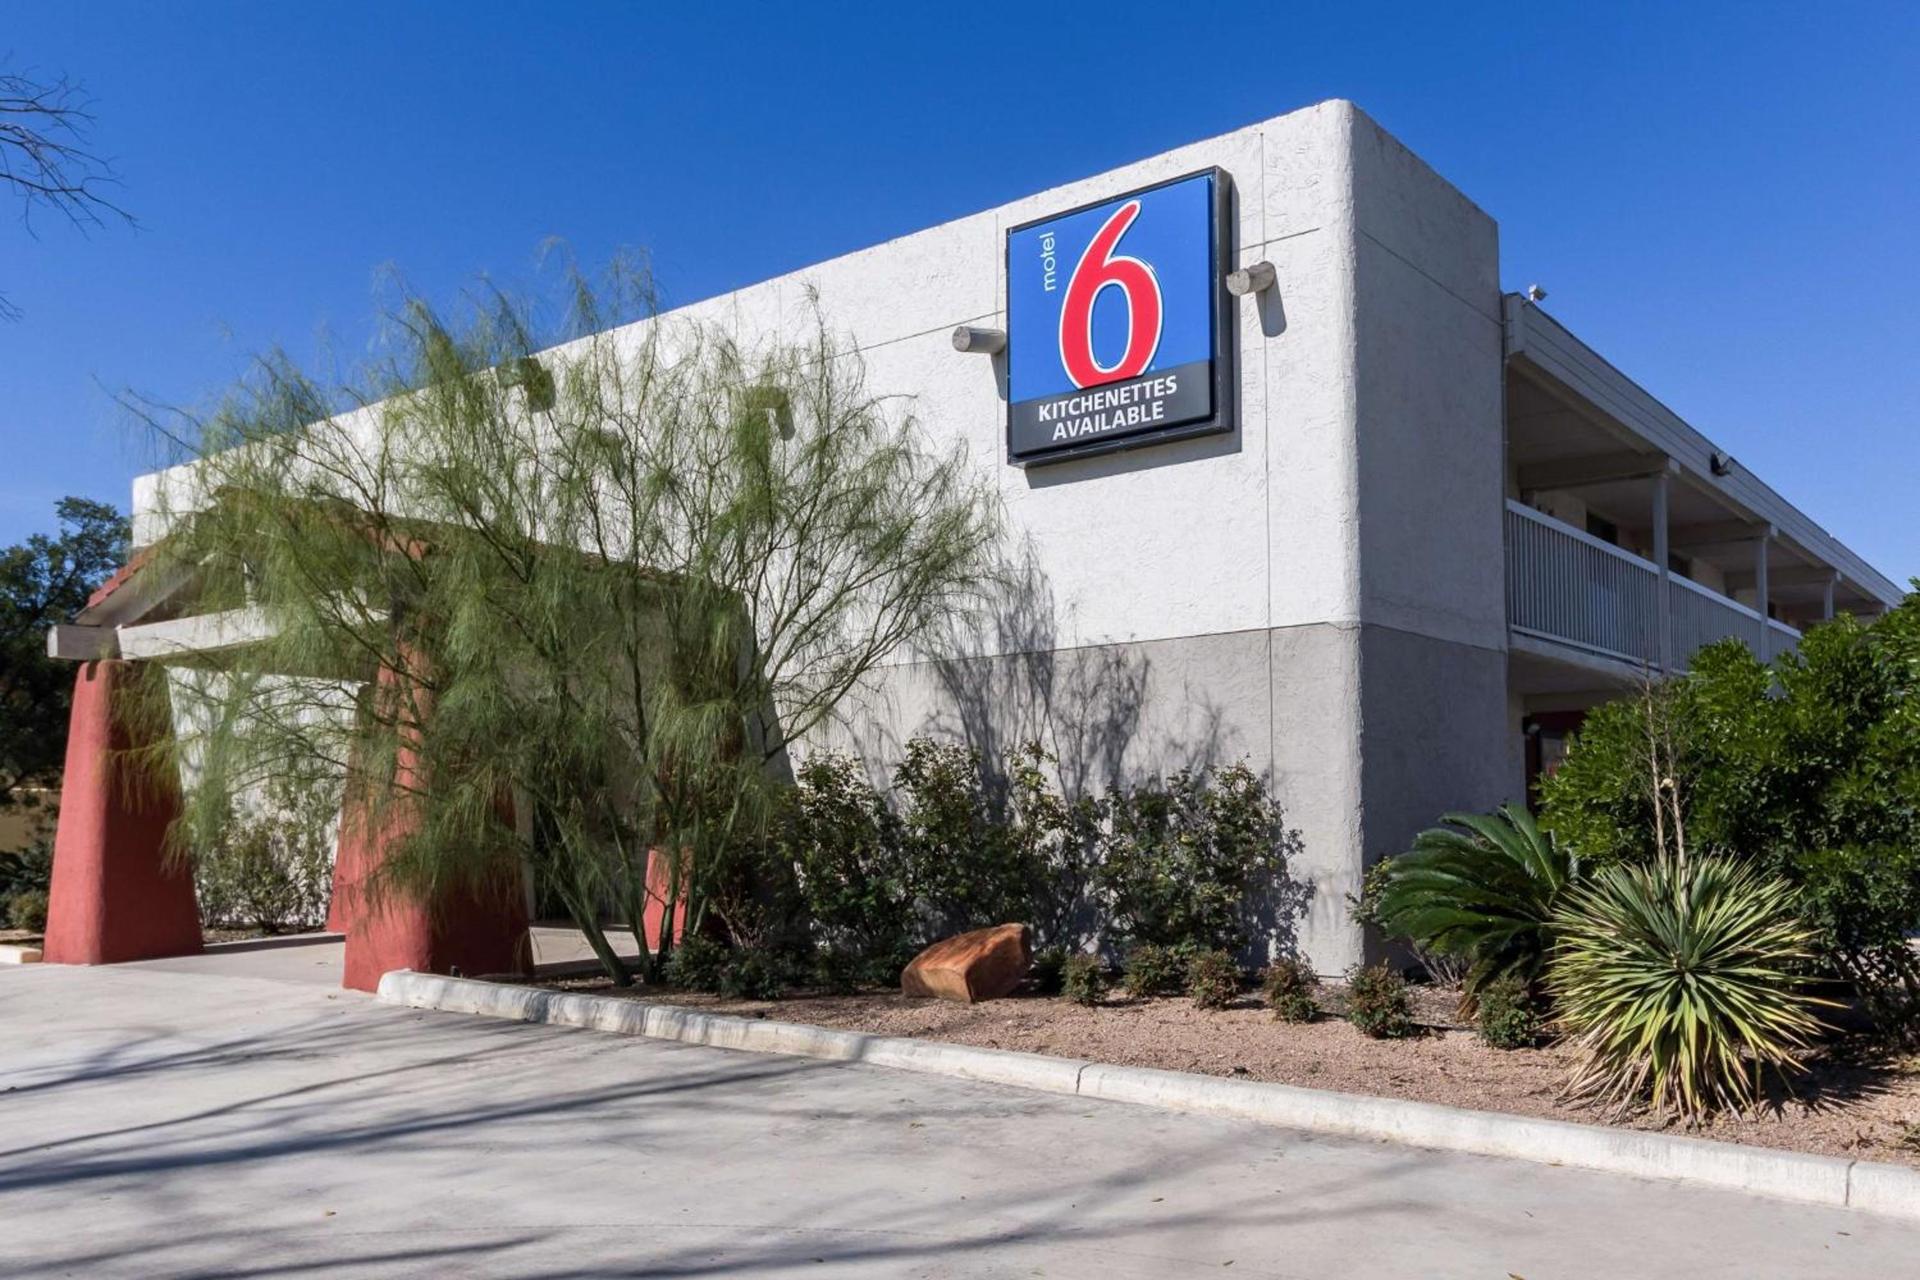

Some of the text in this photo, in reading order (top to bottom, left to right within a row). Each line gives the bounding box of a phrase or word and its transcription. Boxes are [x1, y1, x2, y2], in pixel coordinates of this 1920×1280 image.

[1039, 199, 1163, 390] motel 6
[1038, 375, 1177, 422] KITCHENETTES
[1052, 401, 1164, 441] AVAILABLE
